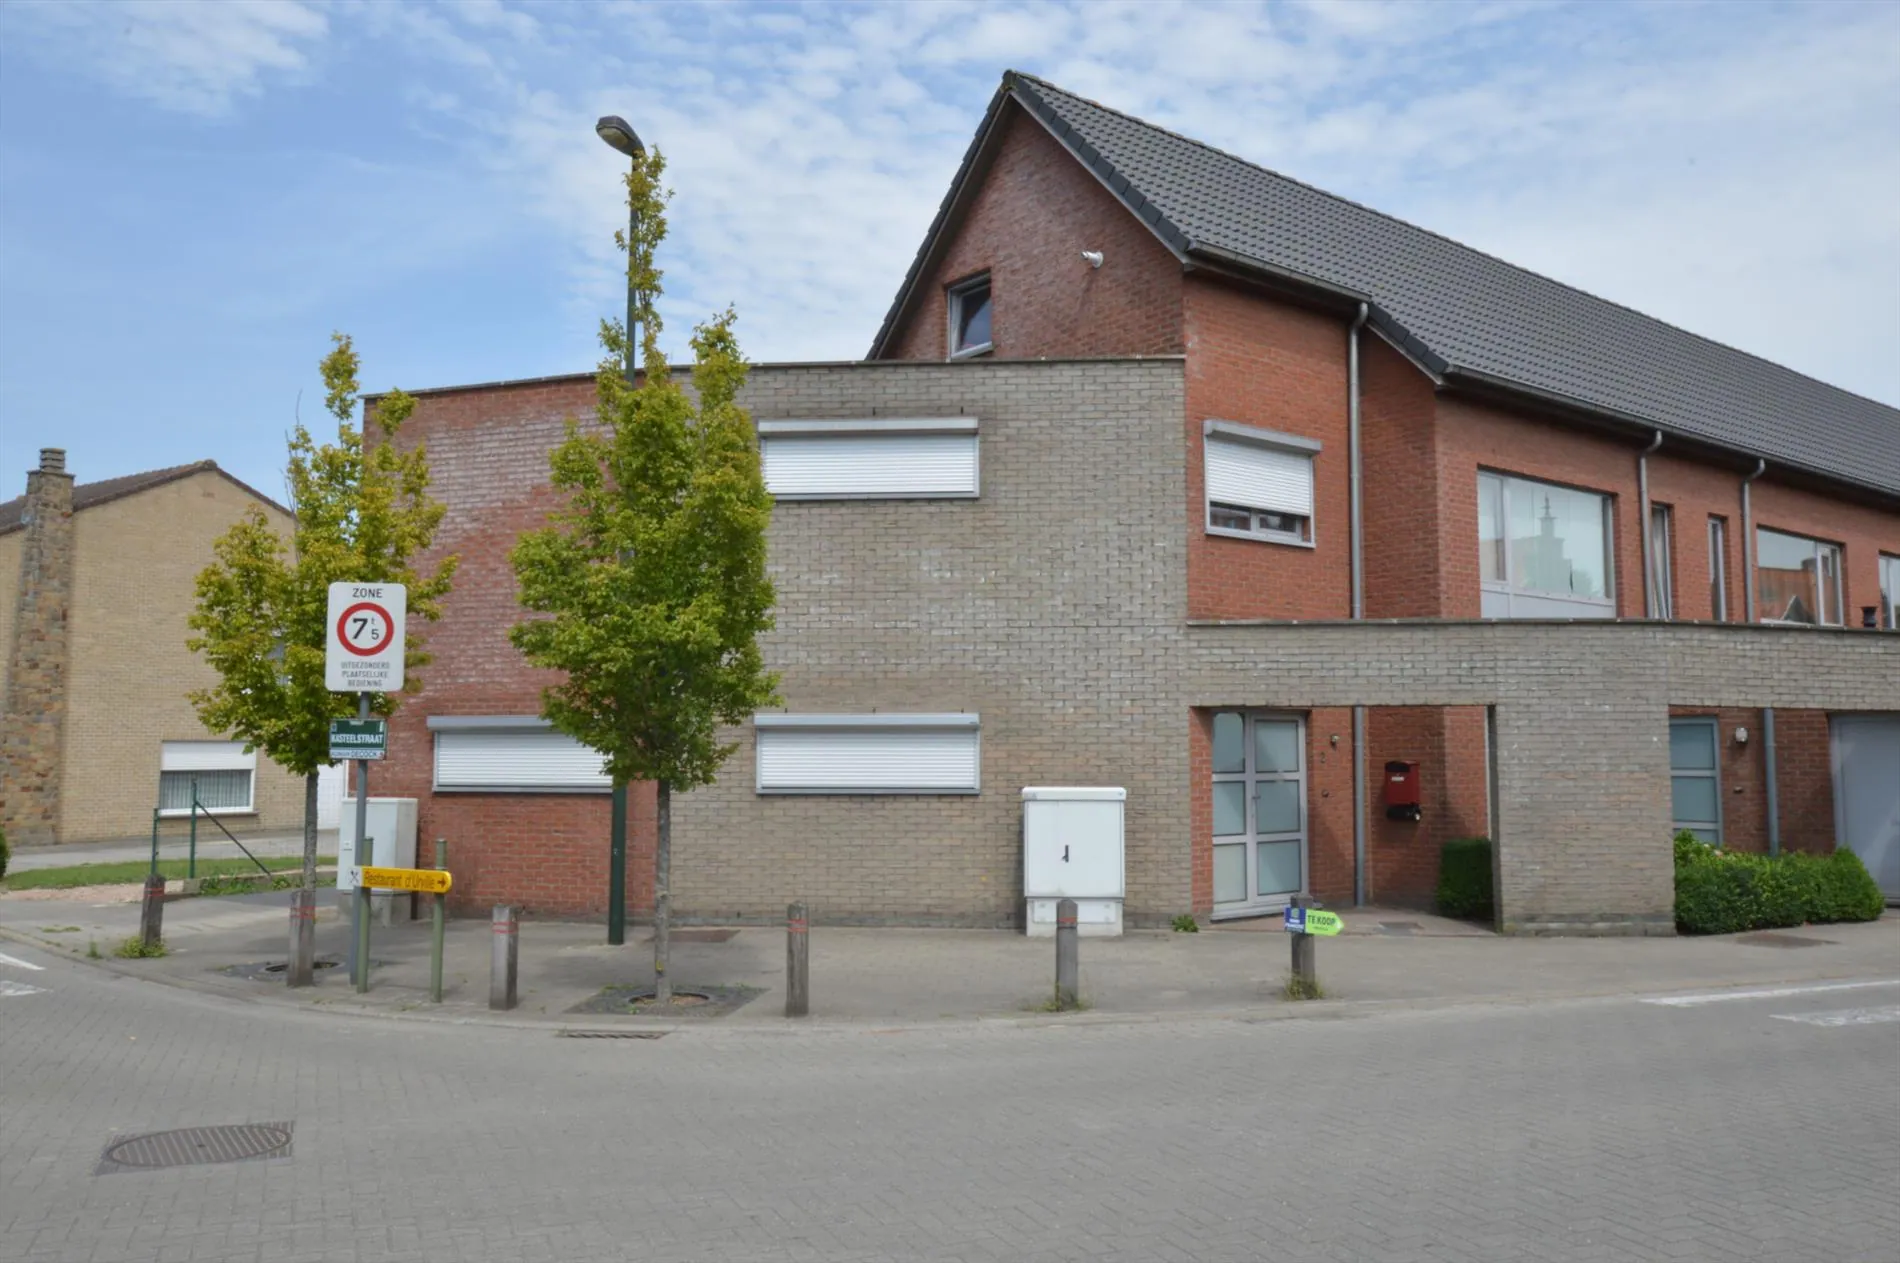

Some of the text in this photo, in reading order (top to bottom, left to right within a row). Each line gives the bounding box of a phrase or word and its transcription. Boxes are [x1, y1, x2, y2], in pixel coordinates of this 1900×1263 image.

[352, 588, 383, 598] ZONE
[331, 734, 383, 744] KASTEELSTRAAT
[365, 870, 402, 887] Restaurant
[1308, 915, 1316, 924] TE
[1317, 916, 1335, 926] KOOP
